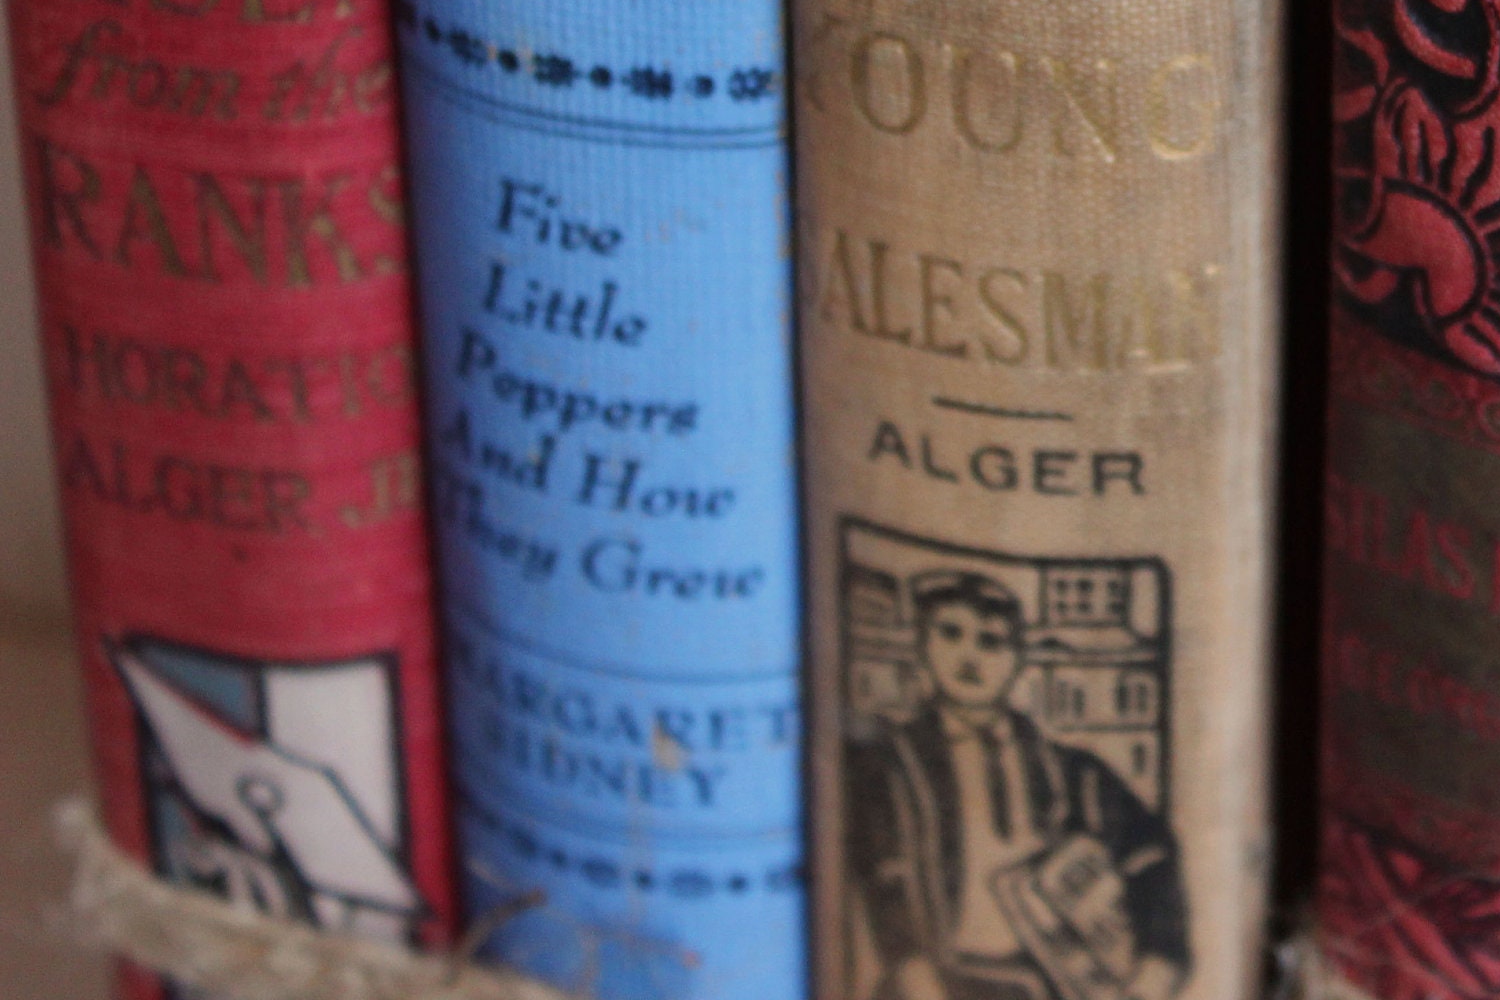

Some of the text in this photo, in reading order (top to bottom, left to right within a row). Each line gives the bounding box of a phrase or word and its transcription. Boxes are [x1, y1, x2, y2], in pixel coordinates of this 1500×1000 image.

[36, 17, 391, 126] from the
[33, 130, 402, 290] RANKS
[496, 176, 625, 259] Five
[482, 262, 647, 347] Little
[816, 226, 1222, 376] ALESMAN
[456, 325, 701, 435] Peppers
[64, 428, 326, 538] ALGER
[444, 408, 737, 519] And How
[867, 420, 1147, 497] ALGER
[578, 536, 767, 600] Grow
